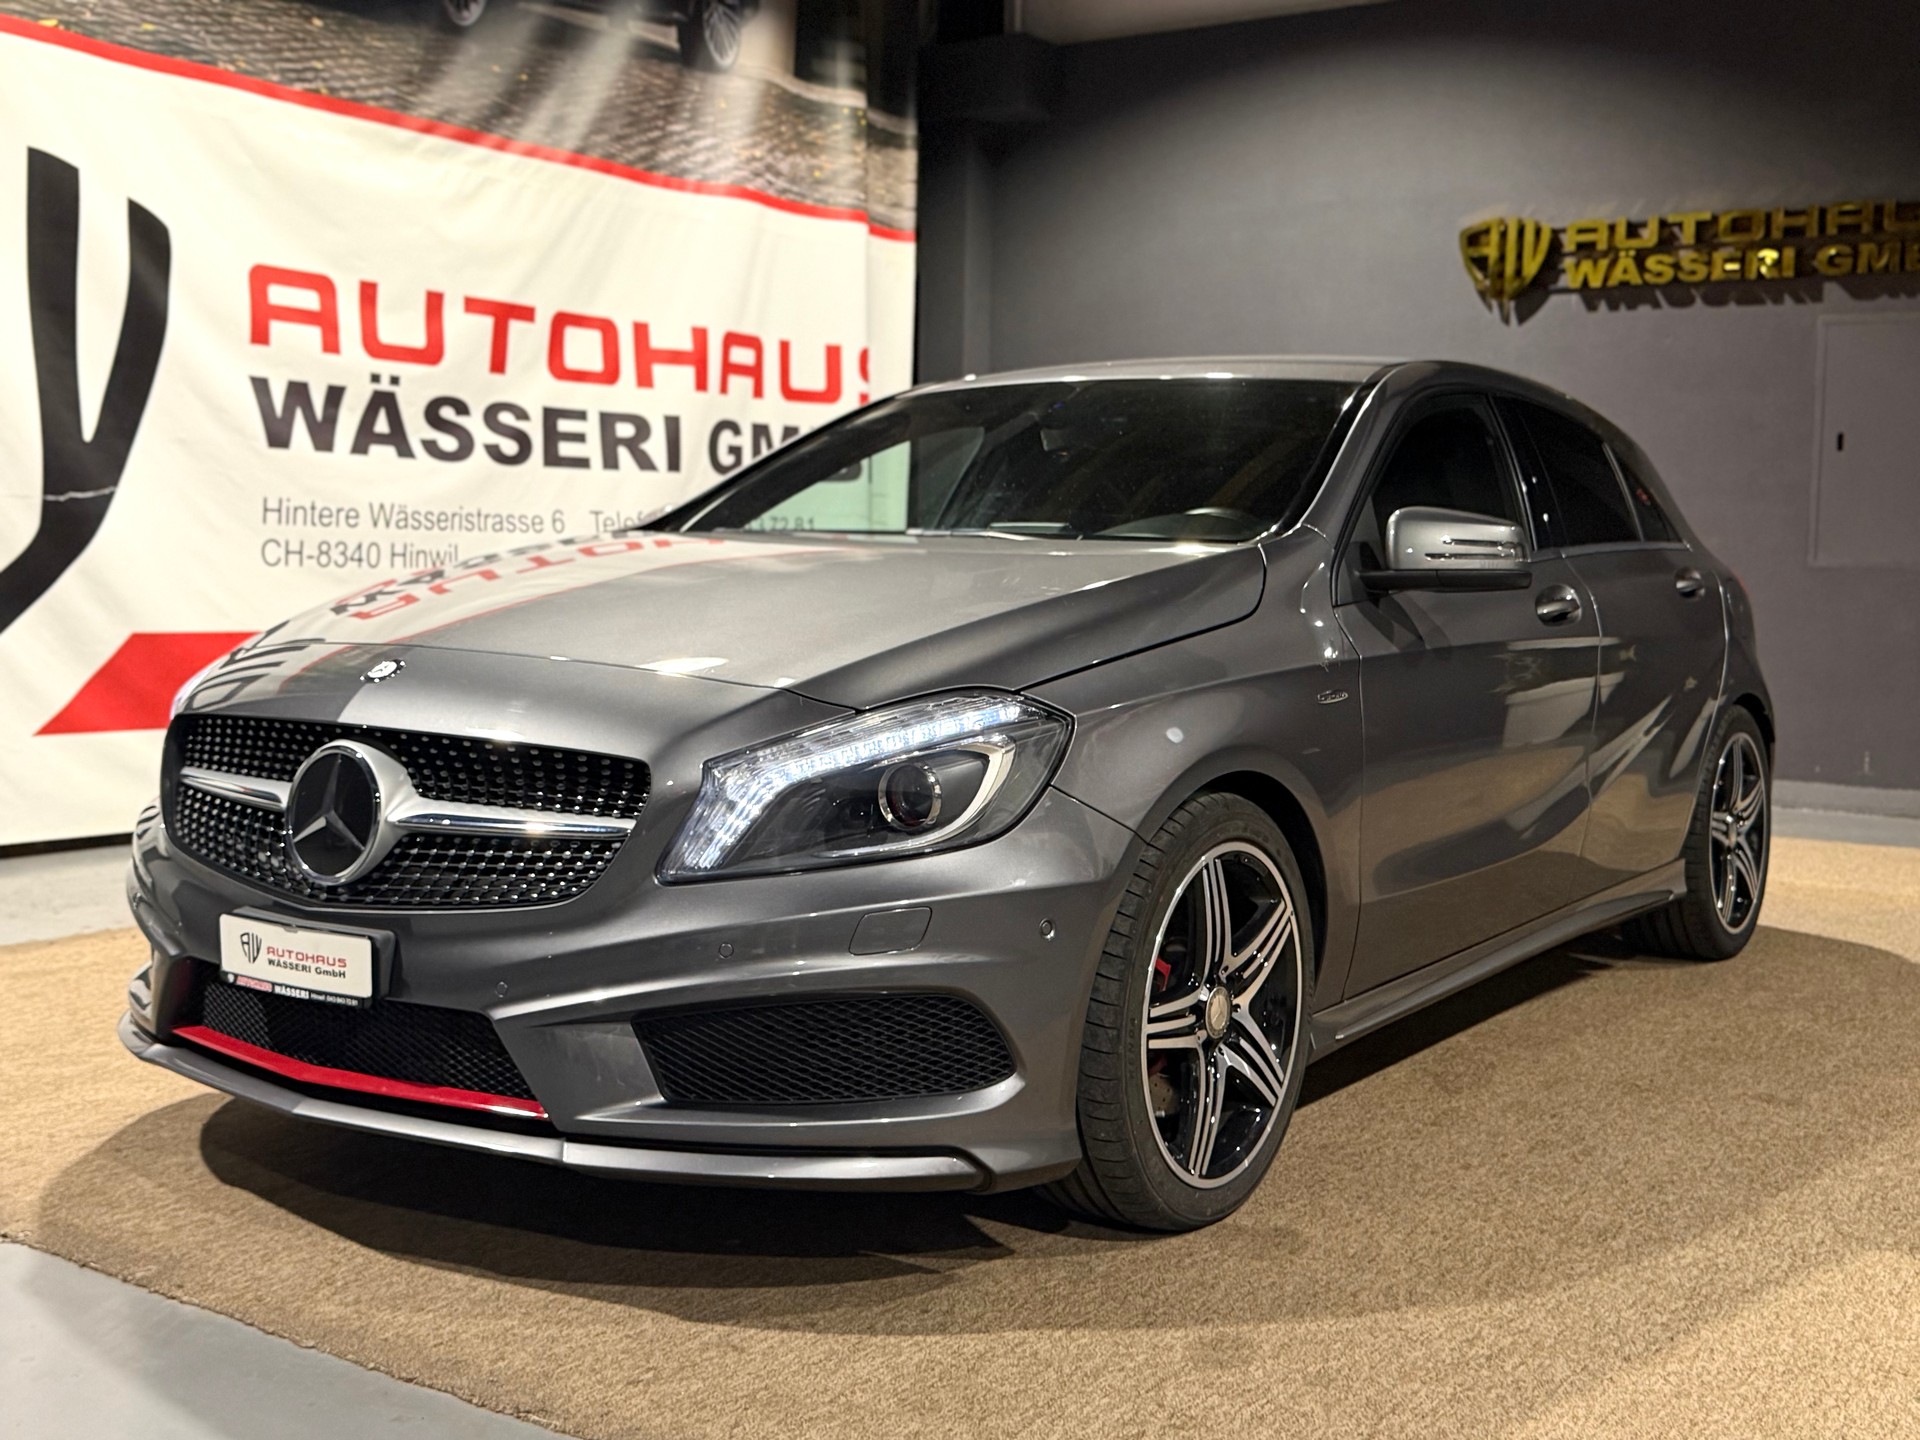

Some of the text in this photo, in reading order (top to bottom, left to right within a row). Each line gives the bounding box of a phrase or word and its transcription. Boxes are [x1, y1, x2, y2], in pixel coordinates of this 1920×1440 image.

[1563, 248, 1796, 290] WÄSSERI
[248, 373, 683, 474] WÄSSERI
[262, 497, 360, 529] Hintere
[369, 502, 545, 535] Wässeristrasse
[551, 509, 566, 534] 6
[260, 538, 381, 570] CH-8340
[389, 542, 459, 570] Hinwil
[266, 946, 347, 968] AUTOHAUS
[314, 966, 347, 979] GmbH
